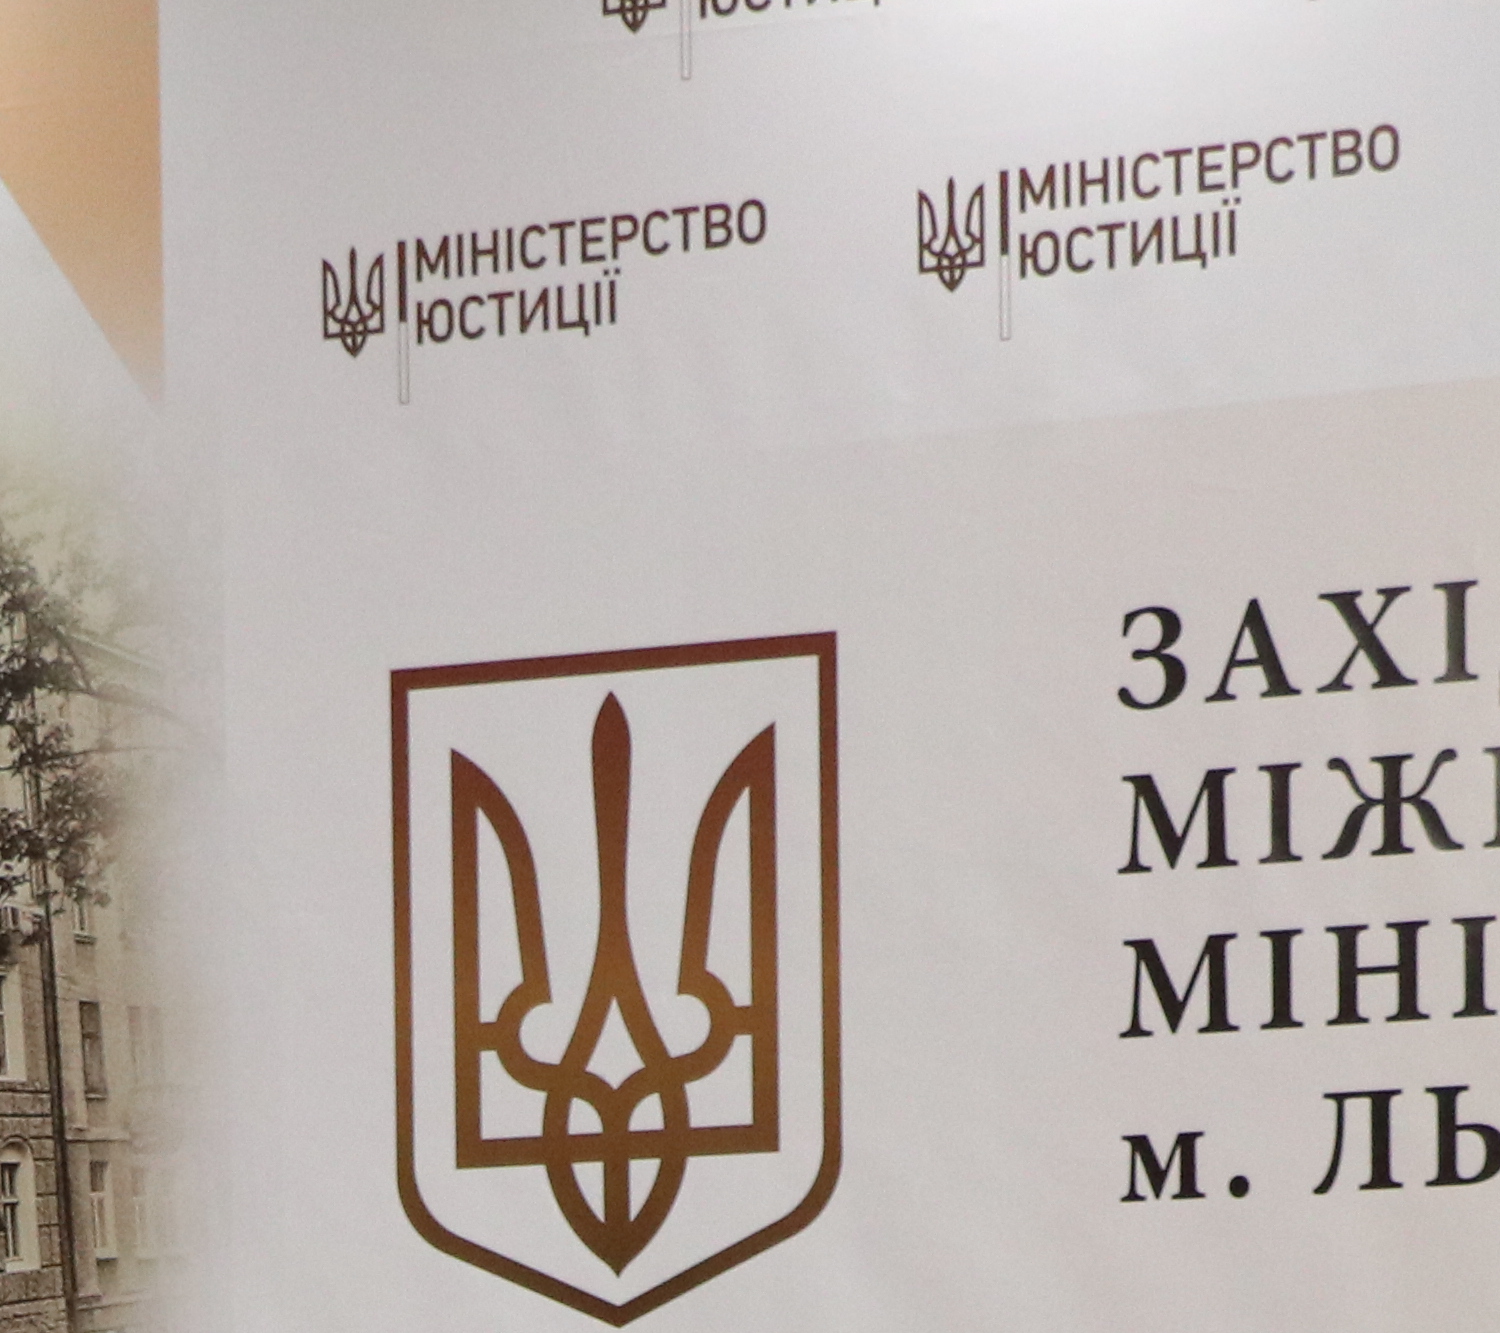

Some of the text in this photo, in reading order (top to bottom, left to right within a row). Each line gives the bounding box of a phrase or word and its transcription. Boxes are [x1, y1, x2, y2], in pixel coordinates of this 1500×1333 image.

[1018, 124, 1402, 213] МІНІСТЕРСТВО
[413, 199, 767, 281] МІНІСТЕРСТВО
[1018, 197, 1238, 280] ЮСТИЦІЇ
[415, 269, 619, 345] ЮСТИЦІЇ
[1121, 1130, 1250, 1202] м.
